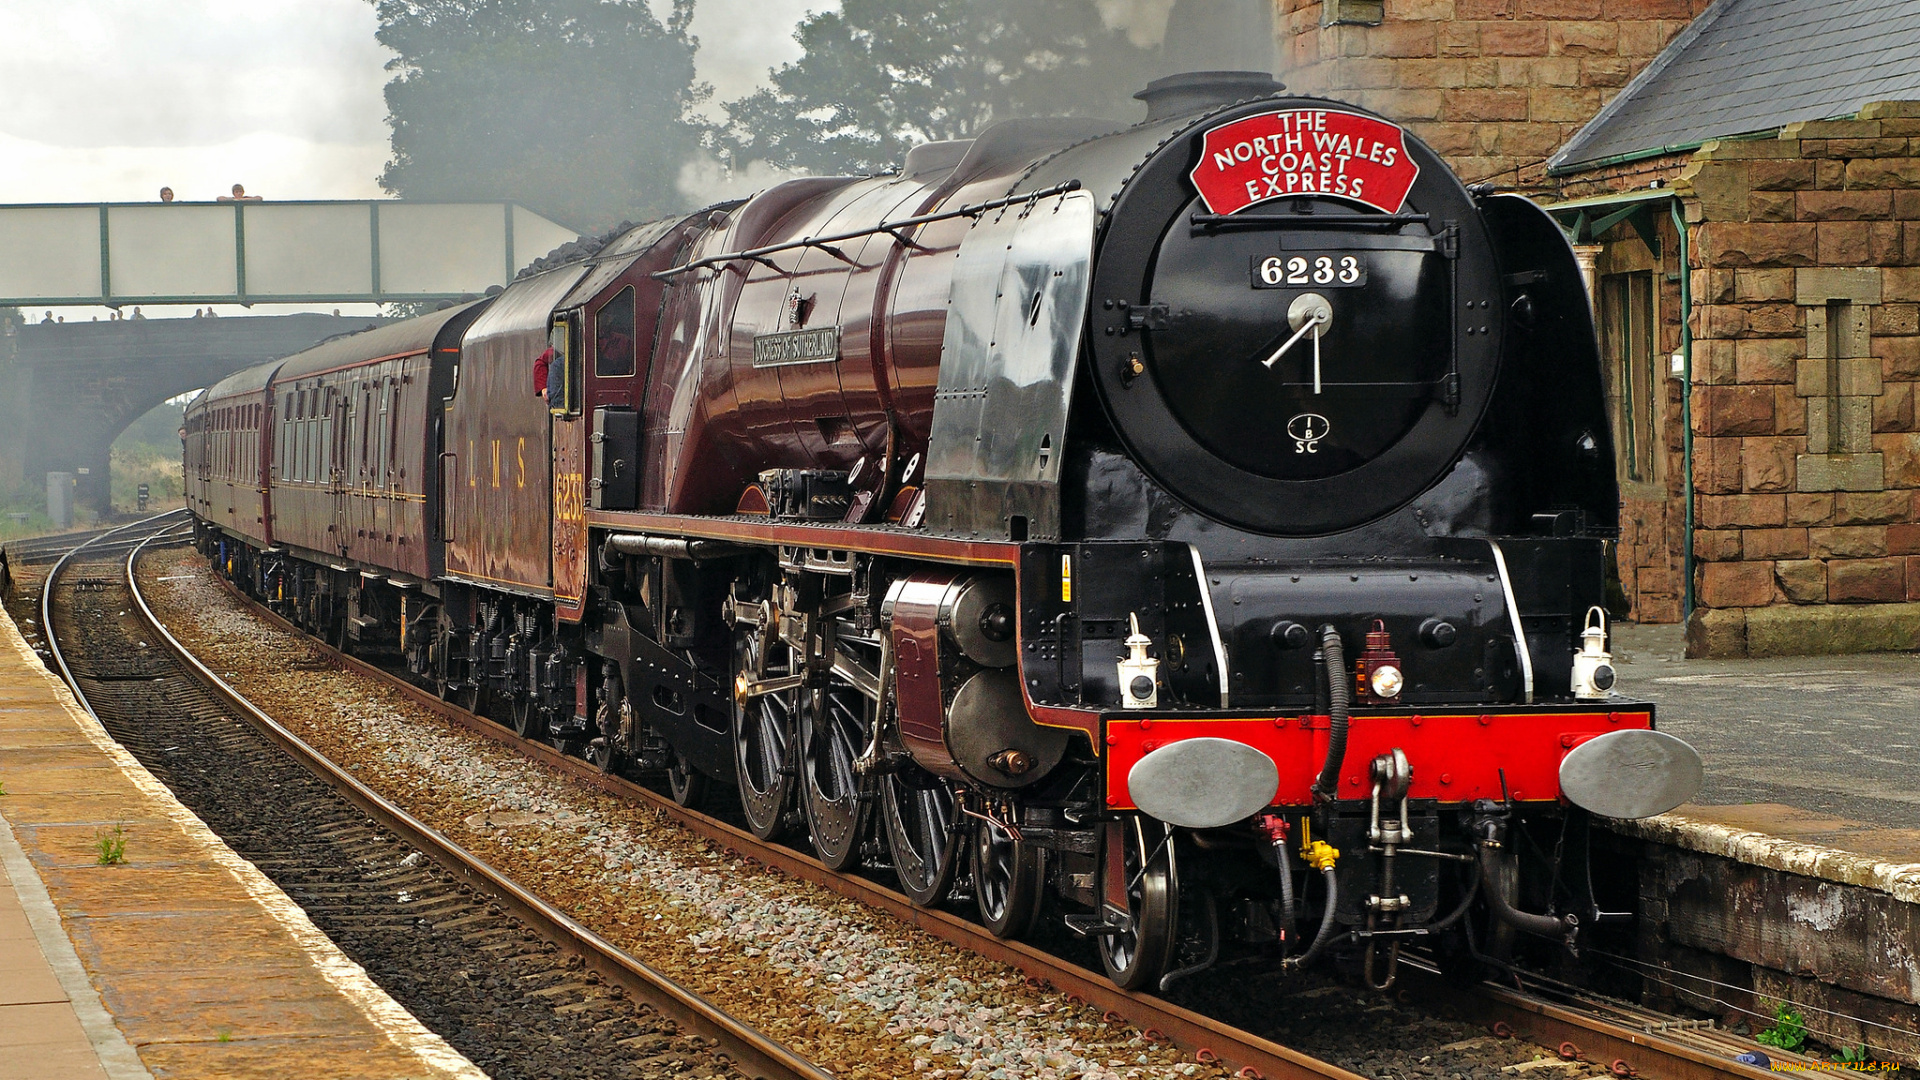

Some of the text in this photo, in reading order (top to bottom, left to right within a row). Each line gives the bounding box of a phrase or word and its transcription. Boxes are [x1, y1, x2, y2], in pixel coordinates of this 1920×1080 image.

[1278, 112, 1326, 133] THE
[1213, 131, 1397, 172] NORTH WALES
[1261, 151, 1351, 175] COAST
[1245, 172, 1364, 202] EXPRESS
[1261, 256, 1359, 284] 6233
[782, 336, 791, 359] OF
[792, 332, 834, 359] SUTHERLAND
[1295, 441, 1318, 454] SC
[556, 473, 583, 521] 6233
